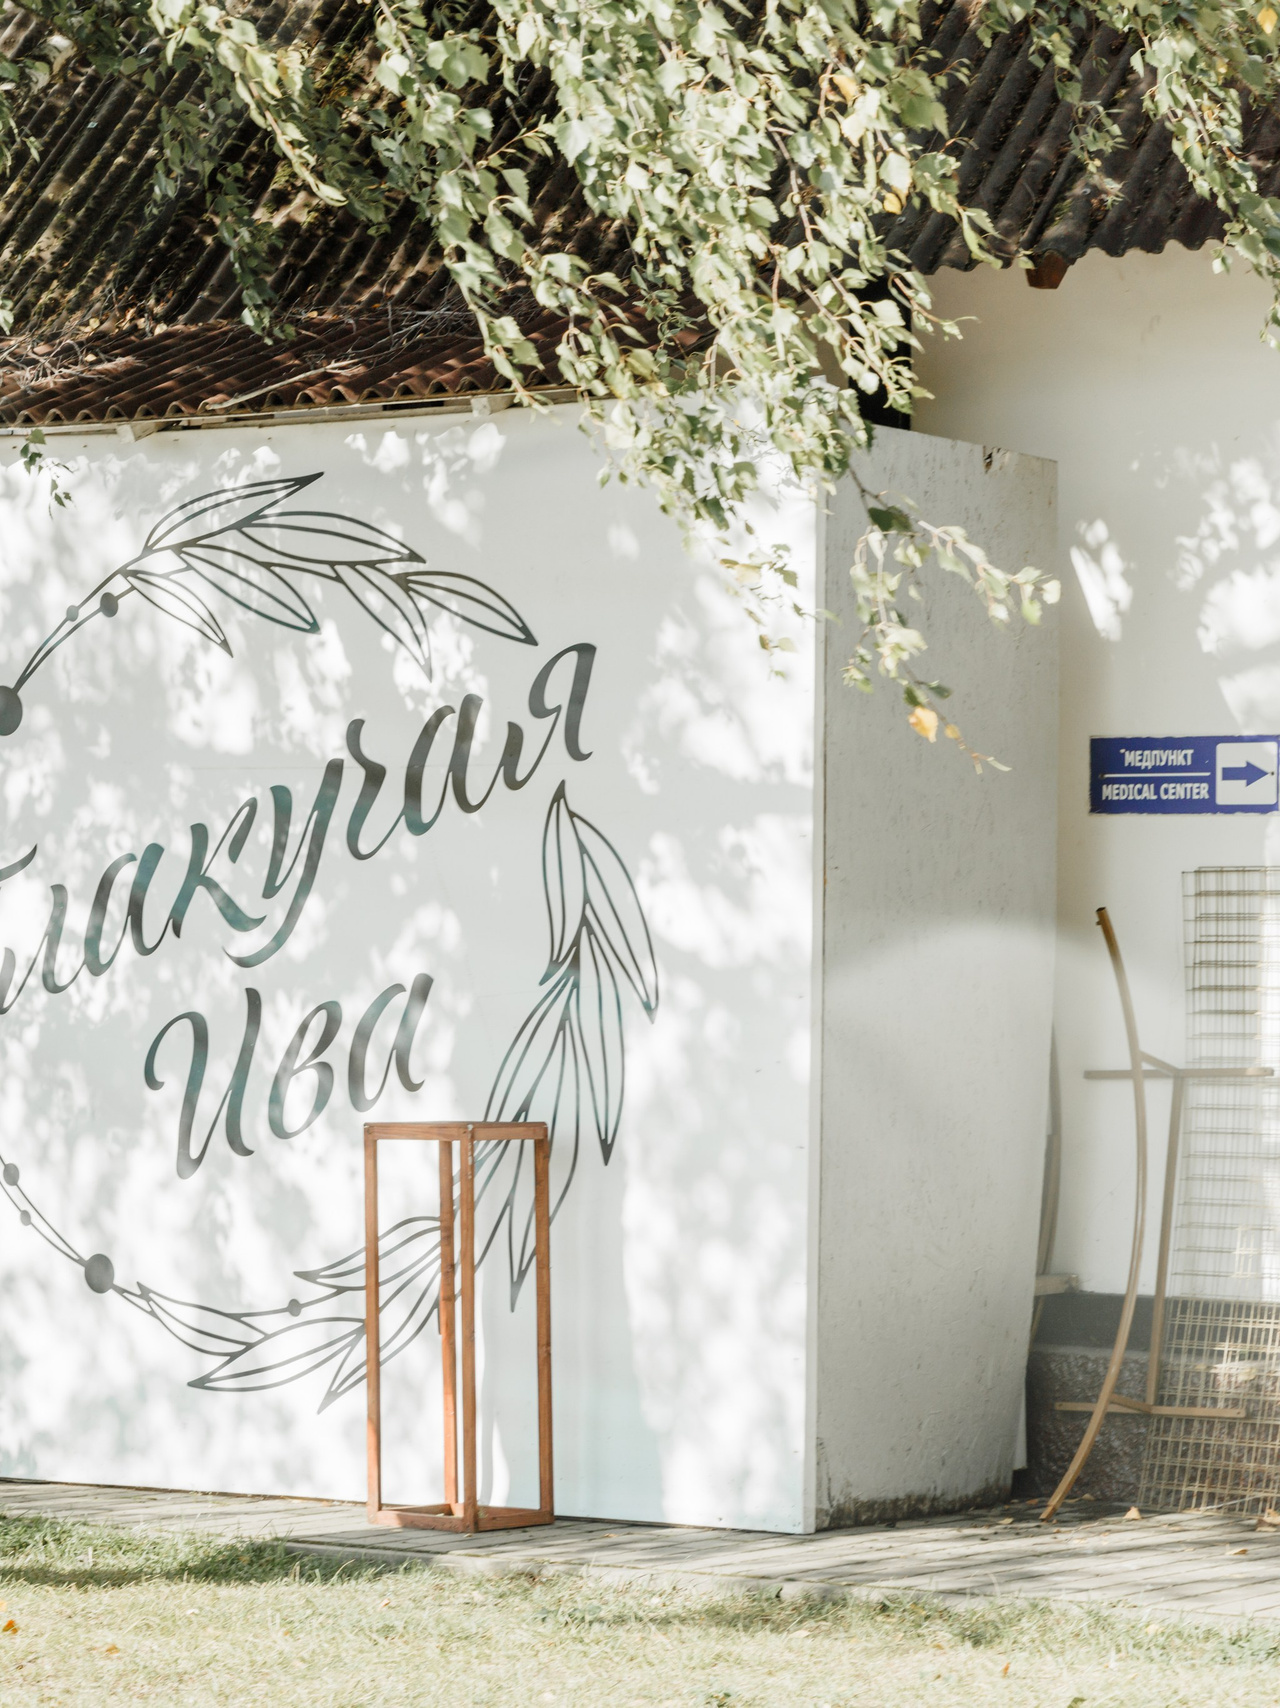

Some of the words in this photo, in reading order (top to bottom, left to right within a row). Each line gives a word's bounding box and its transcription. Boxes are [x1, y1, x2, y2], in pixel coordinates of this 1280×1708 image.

[1124, 749, 1194, 770] МЕДПУНКТ
[1102, 783, 1157, 801] MEDICAL
[1160, 783, 1210, 800] CENTER
[144, 973, 434, 1179] Ива
